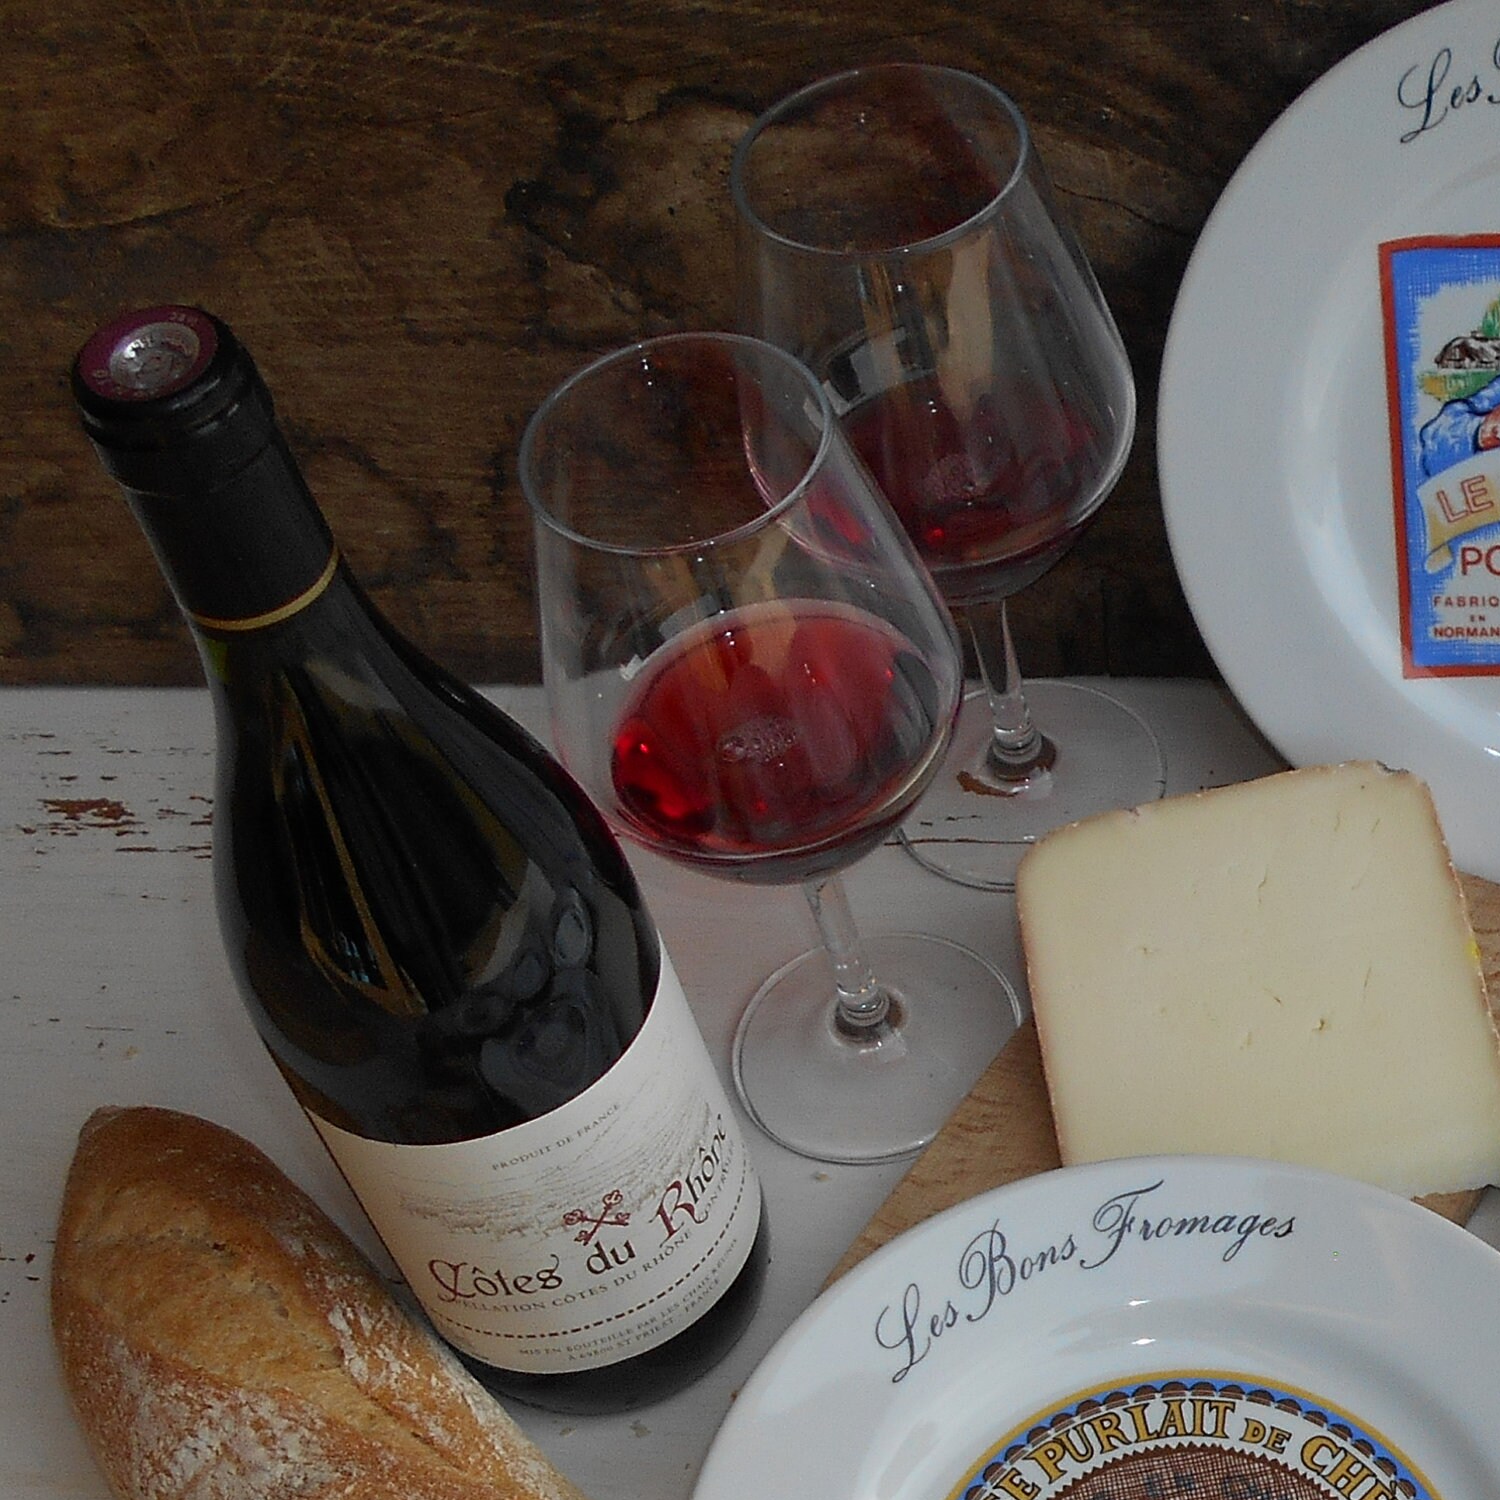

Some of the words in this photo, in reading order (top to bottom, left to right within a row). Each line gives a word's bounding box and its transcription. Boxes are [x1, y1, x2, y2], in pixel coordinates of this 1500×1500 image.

[1398, 48, 1483, 143] Les
[1436, 475, 1495, 523] LE
[492, 1145, 552, 1171] PRODUIT
[556, 1136, 574, 1147] DE
[577, 1104, 619, 1137] FRANCE
[429, 1254, 563, 1302] Côtes
[586, 1239, 636, 1275] du
[649, 1113, 727, 1248] Rhône
[553, 1284, 608, 1307] CÔTES
[613, 1271, 637, 1286] DU
[642, 1229, 693, 1272] RHÔNE
[875, 1283, 959, 1383] Les
[959, 1218, 1077, 1321] Bons
[1080, 1180, 1296, 1262] Fromages
[1240, 1417, 1292, 1454] DE
